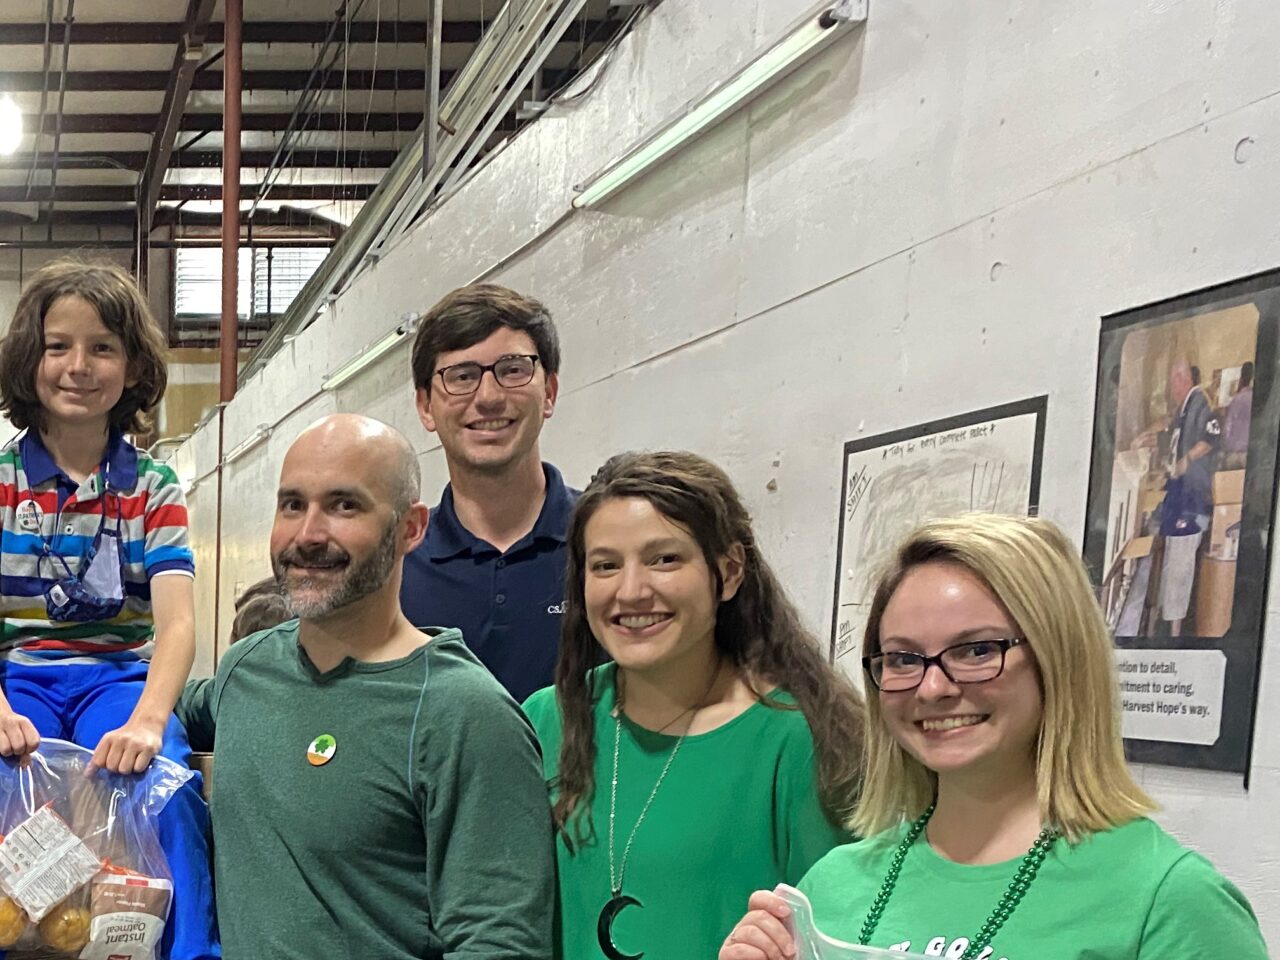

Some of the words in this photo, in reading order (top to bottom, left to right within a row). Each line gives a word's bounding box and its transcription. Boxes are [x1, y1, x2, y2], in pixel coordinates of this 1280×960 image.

[1140, 662, 1149, 674] to
[1152, 683, 1161, 693] to
[1122, 700, 1154, 713] Harvest
[1156, 701, 1187, 716] Hope's
[1189, 705, 1210, 718] way.
[105, 922, 146, 936] Oatmeal
[105, 932, 146, 945] Instant
